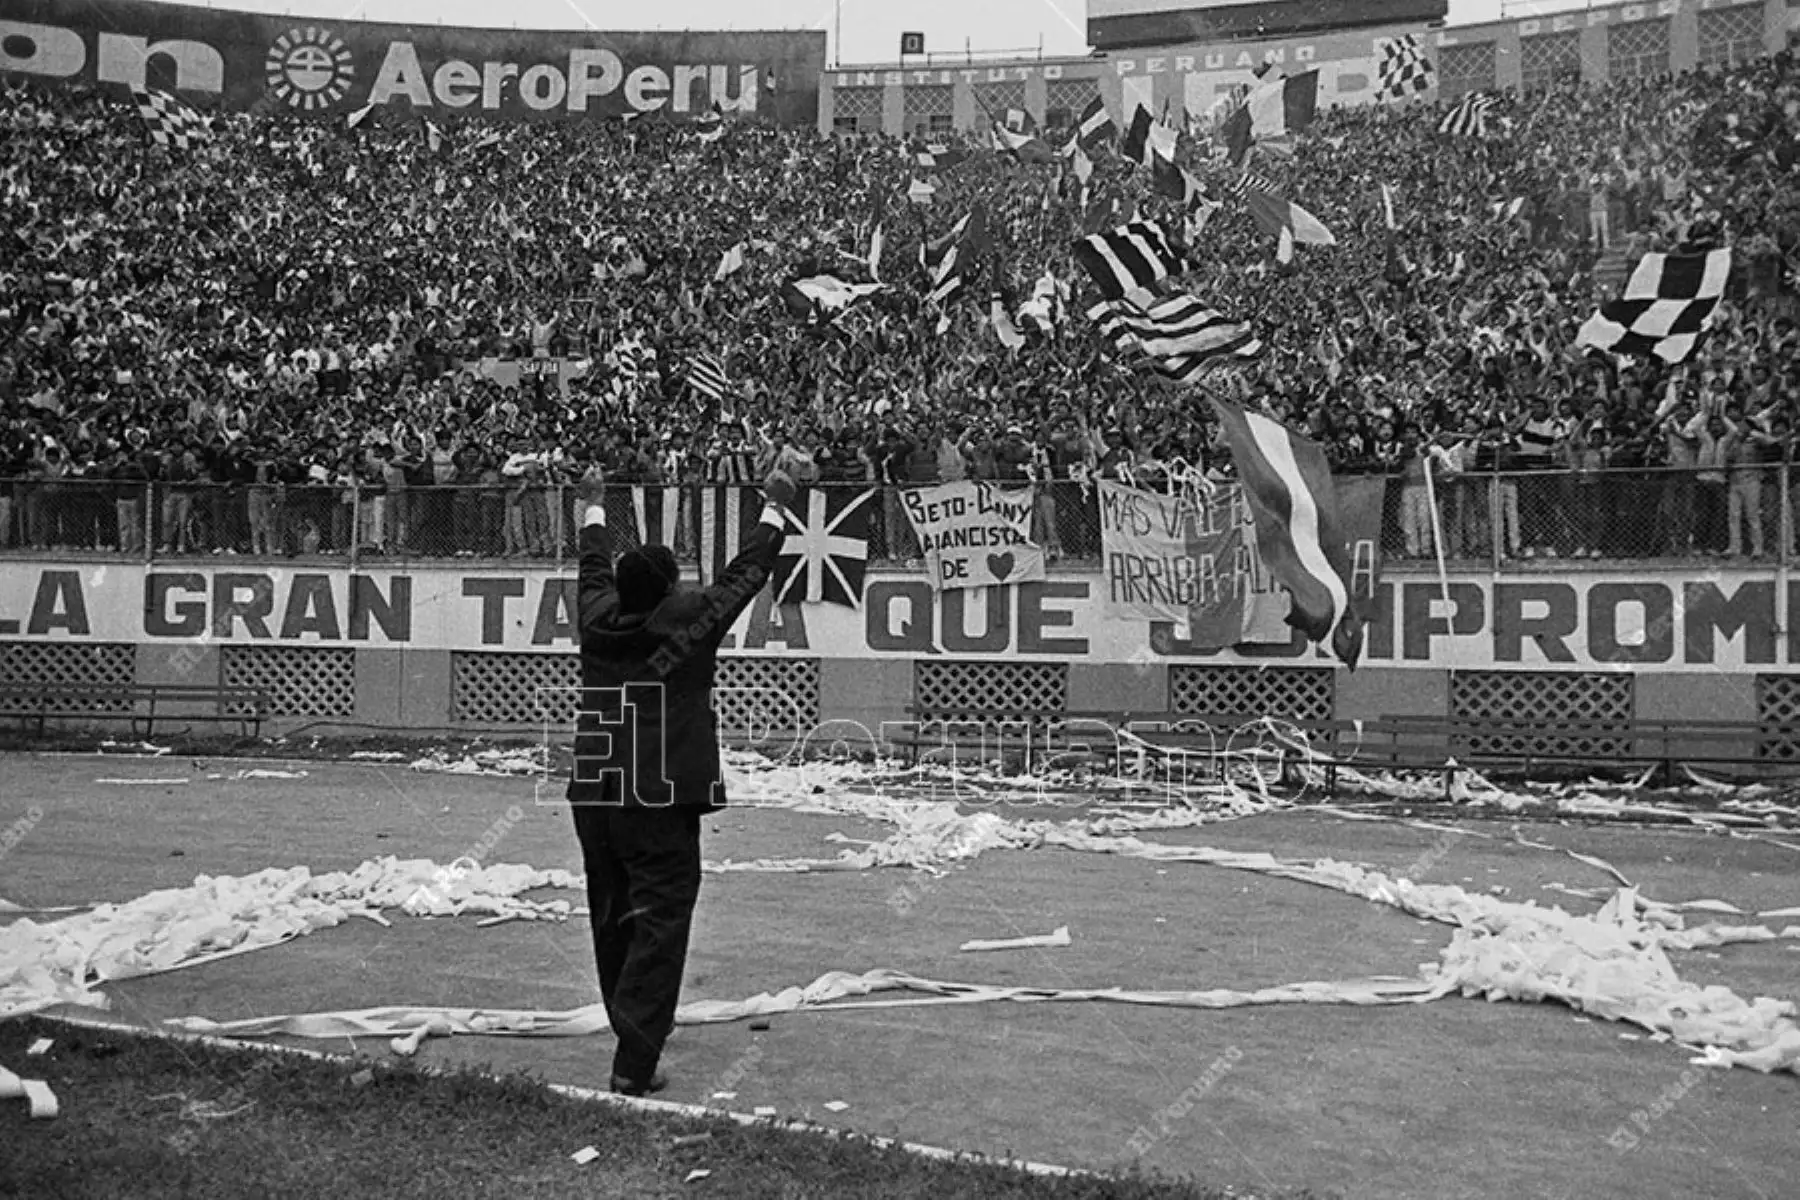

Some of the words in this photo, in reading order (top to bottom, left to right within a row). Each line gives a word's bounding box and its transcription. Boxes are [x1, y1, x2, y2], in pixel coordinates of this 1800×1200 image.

[367, 40, 759, 112] AeroPeru
[836, 64, 1063, 87] INSTITUTO
[1116, 45, 1315, 75] PERUANO
[1101, 490, 1152, 537] MAS
[941, 558, 969, 580] DE
[144, 573, 413, 642] GRAN
[462, 576, 811, 651] TAA
[866, 580, 1090, 655] QUE
